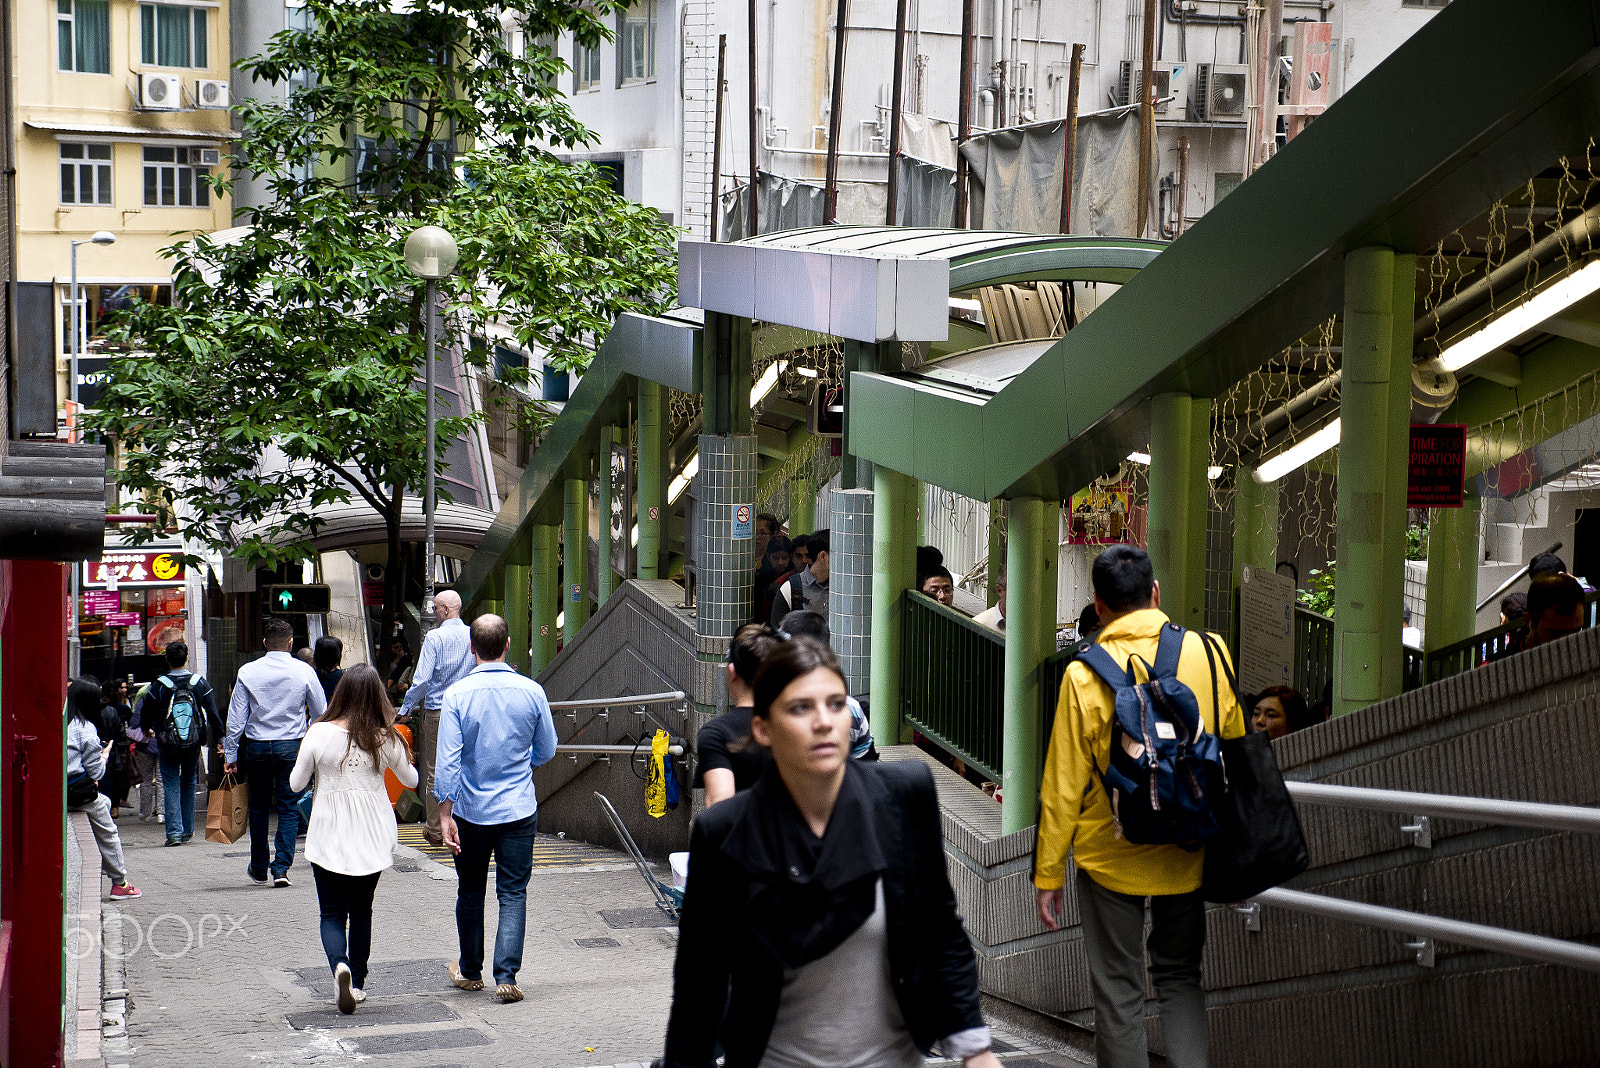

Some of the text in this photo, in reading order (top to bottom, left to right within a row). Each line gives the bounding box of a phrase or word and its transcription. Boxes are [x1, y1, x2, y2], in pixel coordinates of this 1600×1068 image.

[1411, 437, 1462, 451] TIME FOR
[1408, 452, 1460, 465] PIRATION
